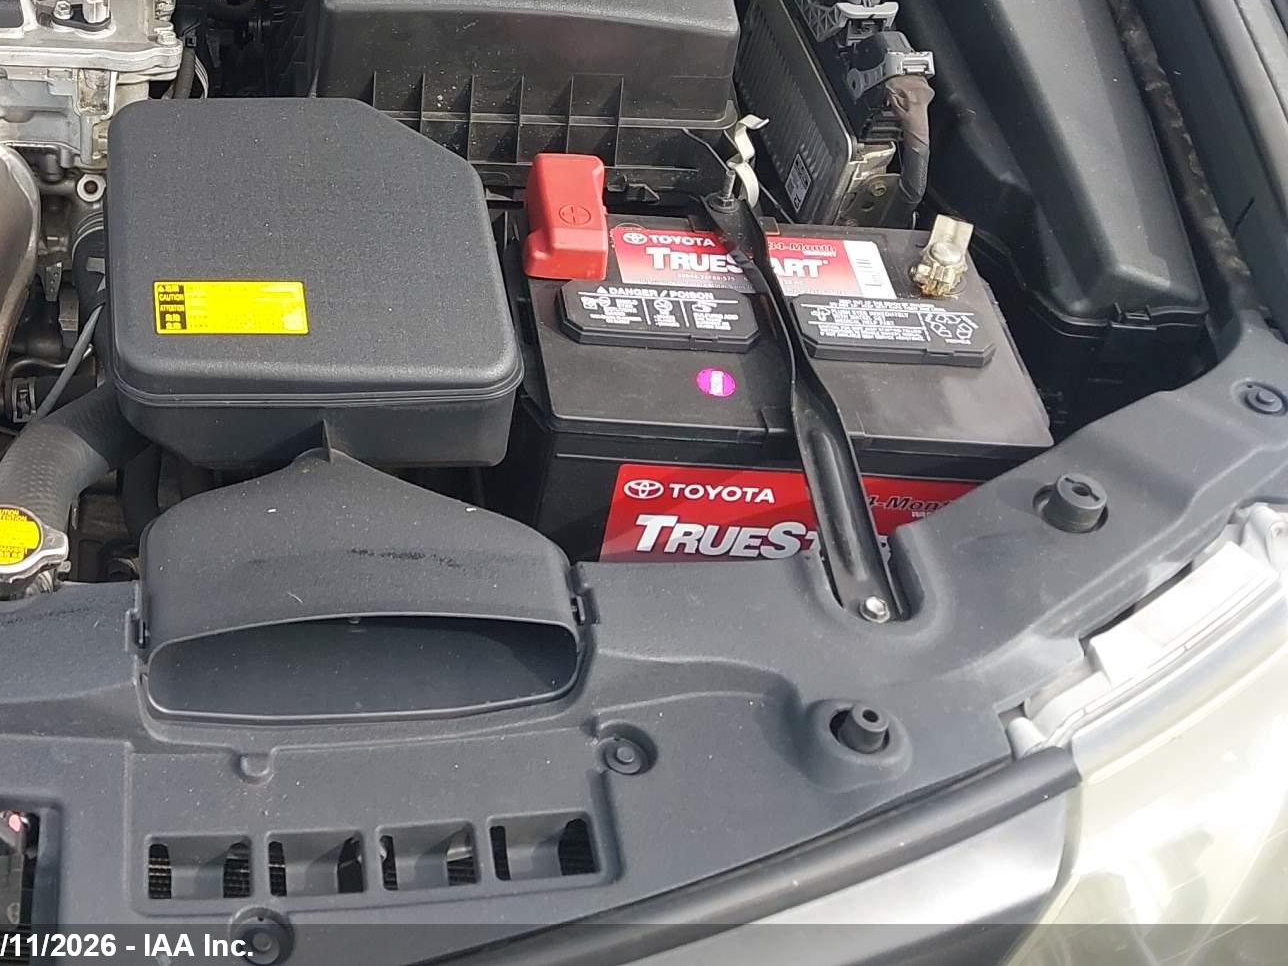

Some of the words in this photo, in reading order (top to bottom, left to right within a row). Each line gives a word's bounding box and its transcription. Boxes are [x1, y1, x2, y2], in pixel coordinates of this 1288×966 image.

[648, 234, 715, 247] TOYOTA
[158, 293, 184, 301] CAUTION
[609, 286, 658, 298] DANGER
[669, 290, 714, 301] POISON
[669, 483, 775, 504] TOYOTA
